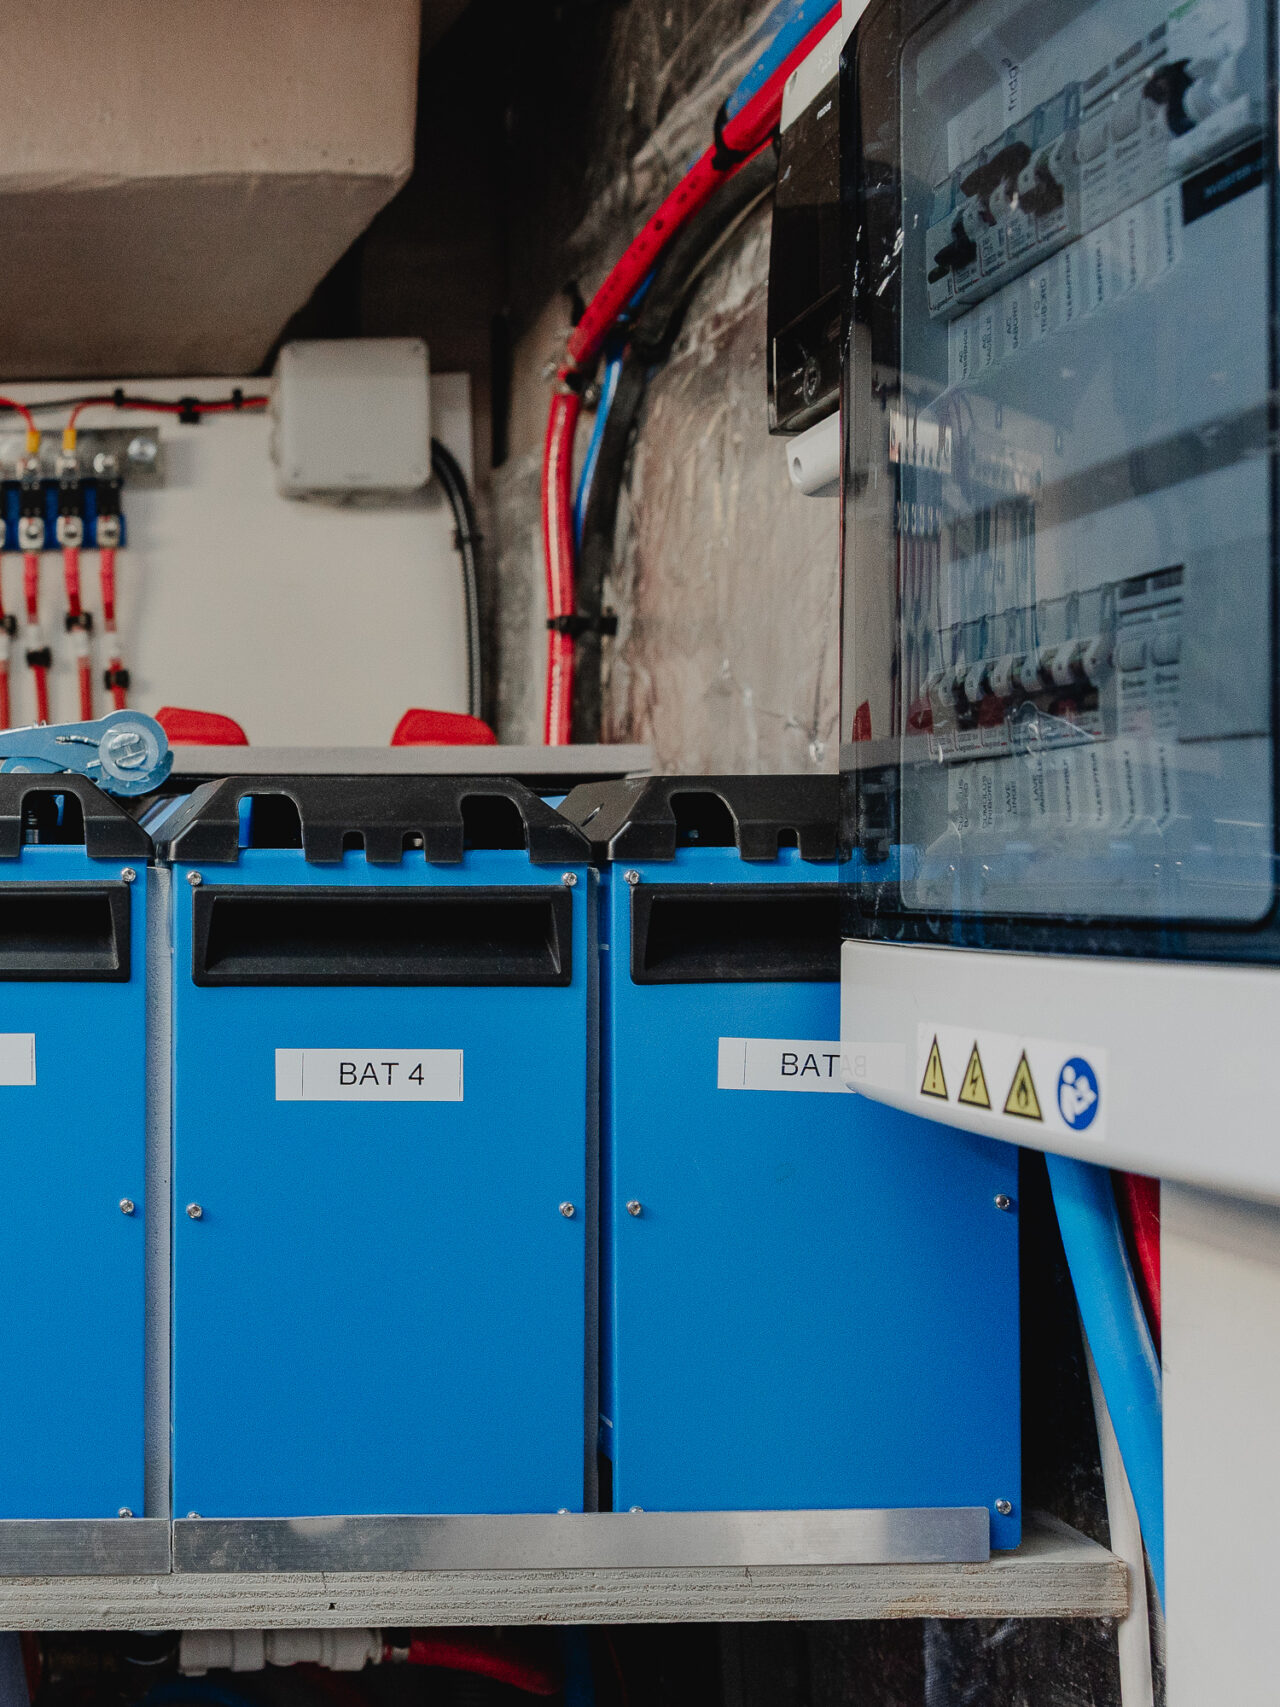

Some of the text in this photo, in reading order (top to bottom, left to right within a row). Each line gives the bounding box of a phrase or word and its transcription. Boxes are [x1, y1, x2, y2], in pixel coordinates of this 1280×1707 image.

[339, 1062, 424, 1085] BAT 4
[781, 1052, 840, 1077] BAT
